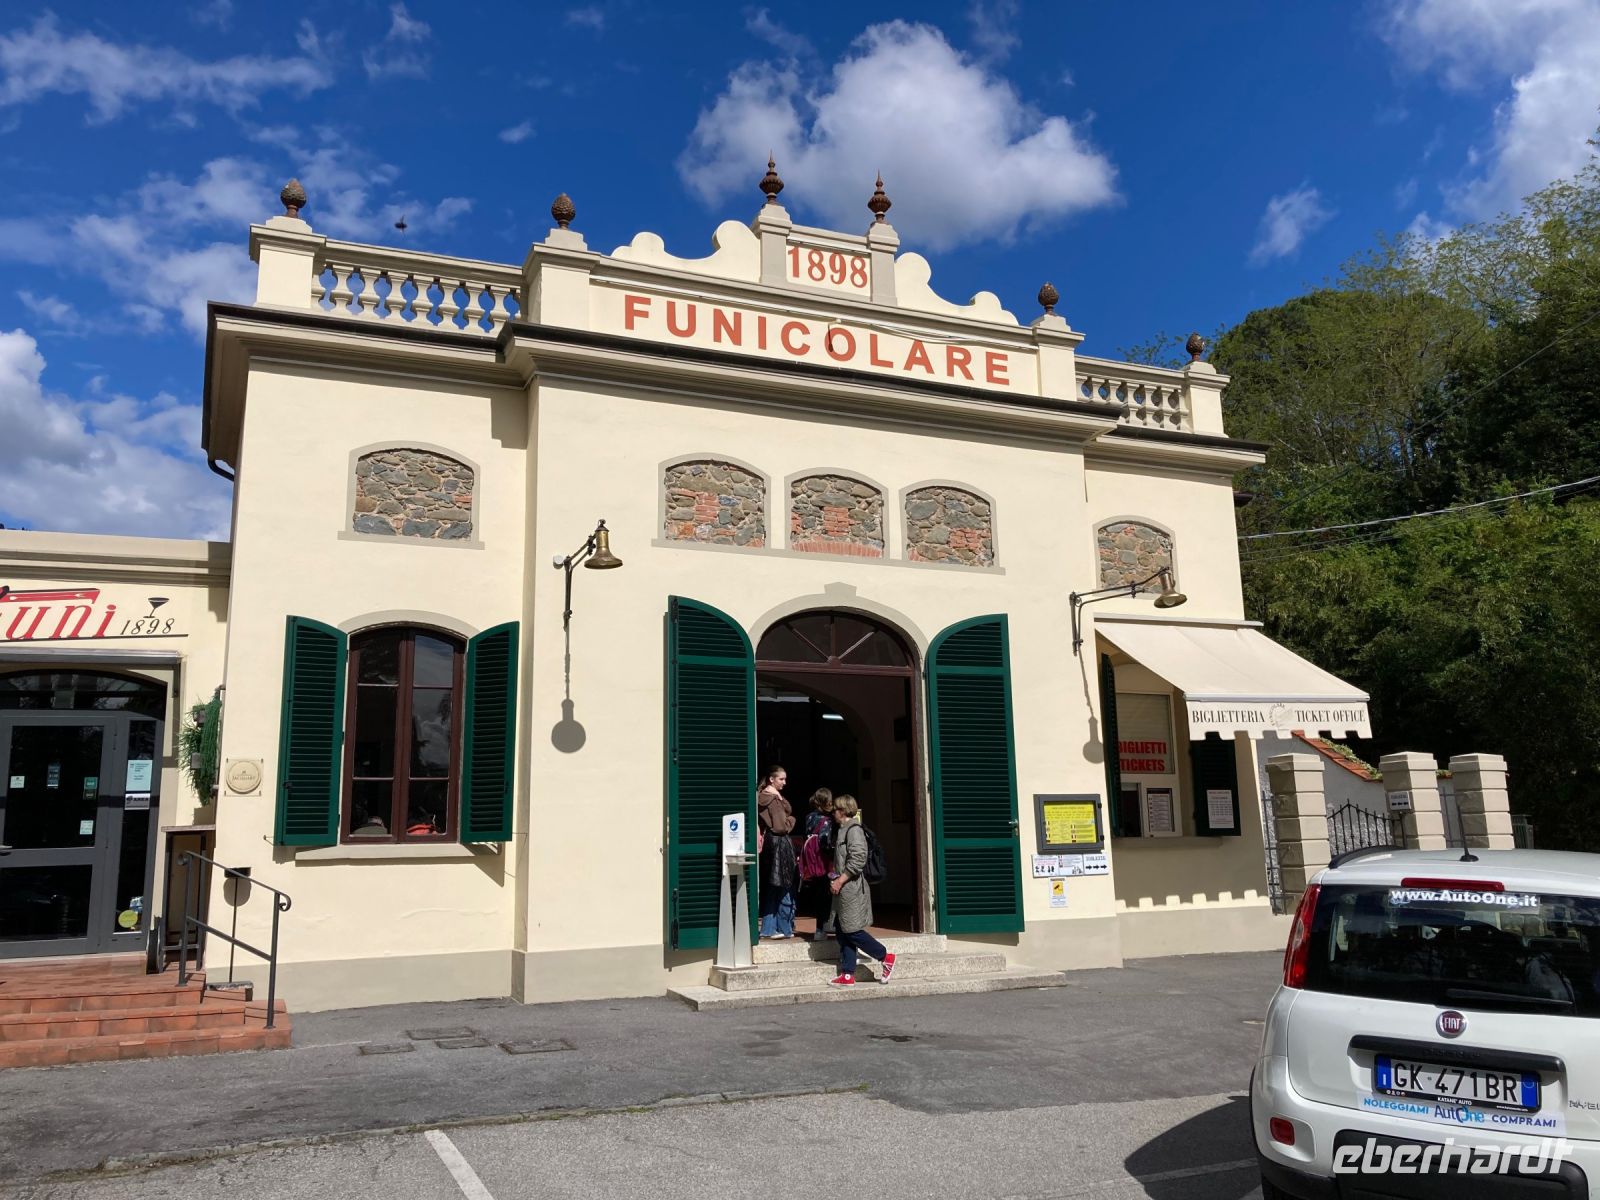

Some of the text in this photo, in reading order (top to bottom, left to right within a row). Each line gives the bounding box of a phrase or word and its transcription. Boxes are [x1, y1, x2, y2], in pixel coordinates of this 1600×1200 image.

[787, 246, 868, 289] 1898
[624, 294, 1011, 386] FUNICOLARE
[0, 592, 175, 641] uni 1898
[1192, 709, 1366, 723] BIGLIETTERIA TICKET OFFICE
[1119, 759, 1166, 772] TICKETS
[1391, 889, 1538, 907] www.AutoOne.it
[1444, 1017, 1460, 1030] FIAT
[1394, 1062, 1518, 1103] GK 471BR
[1363, 1098, 1429, 1115] NOLEGGIAMI
[1492, 1114, 1557, 1128] COMPRAMI
